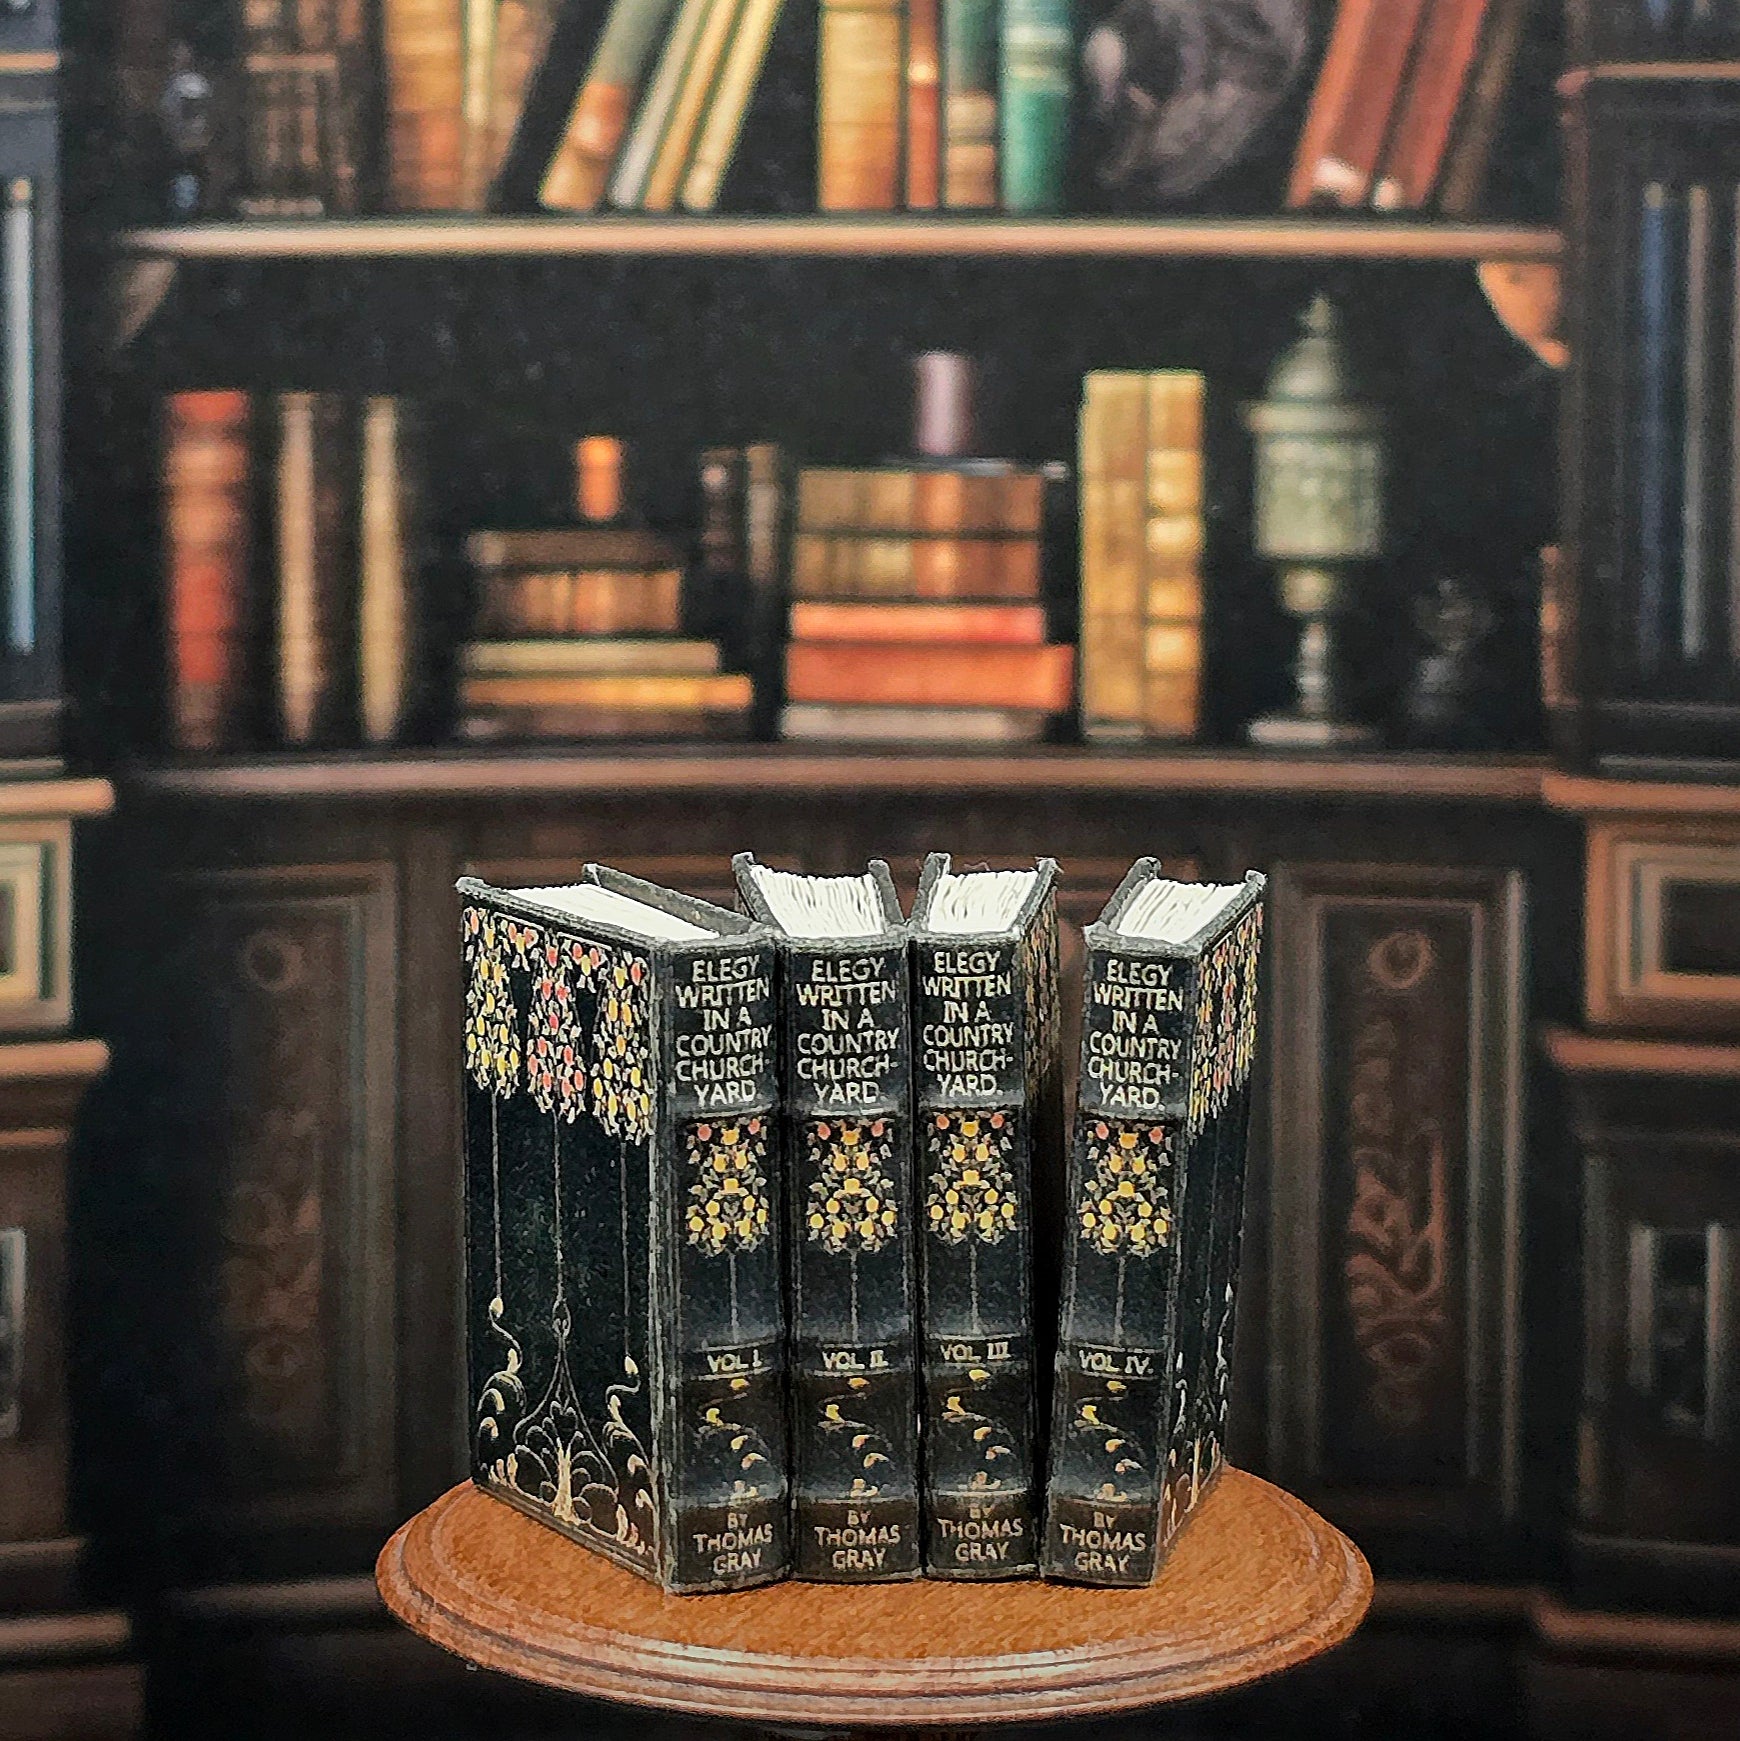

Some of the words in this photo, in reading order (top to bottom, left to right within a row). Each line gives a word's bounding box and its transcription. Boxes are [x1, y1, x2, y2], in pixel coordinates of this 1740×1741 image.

[692, 955, 760, 982] ELEGY
[812, 957, 885, 982] ELEGY
[934, 950, 1000, 974] ELEGY
[1107, 959, 1172, 986] ELEGY
[675, 975, 769, 1008] WRITTEN
[796, 981, 897, 1007] WRITTEN
[922, 972, 1012, 998] WRITTEN
[1092, 982, 1183, 1012] WRITTEN
[704, 1009, 730, 1031] IN
[738, 1006, 752, 1026] A
[822, 1009, 849, 1031] IN
[857, 1008, 875, 1028] A
[943, 1001, 969, 1024] IN
[976, 1001, 991, 1023] A
[1112, 1009, 1137, 1034] IN
[1142, 1013, 1159, 1035] A
[676, 1025, 773, 1057] COUNTRY
[797, 1028, 900, 1055] COUNTRY
[923, 1021, 1014, 1048] COUNTRY
[1089, 1031, 1182, 1061] COUNTRY
[923, 1048, 1014, 1072] CHURCH-
[1087, 1056, 1180, 1085] CHURCH-
[727, 1512, 748, 1529] BY
[847, 1510, 871, 1526] BY
[969, 1502, 996, 1519] BY
[1094, 1511, 1118, 1529] BY
[692, 1523, 773, 1552] THOMAS
[814, 1524, 901, 1547] THOMAS
[936, 1518, 1024, 1540] THOMAS
[1059, 1523, 1147, 1551] THOMAS
[713, 1548, 762, 1575] GRAY
[832, 1547, 886, 1571] GRAY
[955, 1541, 1010, 1562] GRAY
[1074, 1550, 1131, 1574] GRAY
